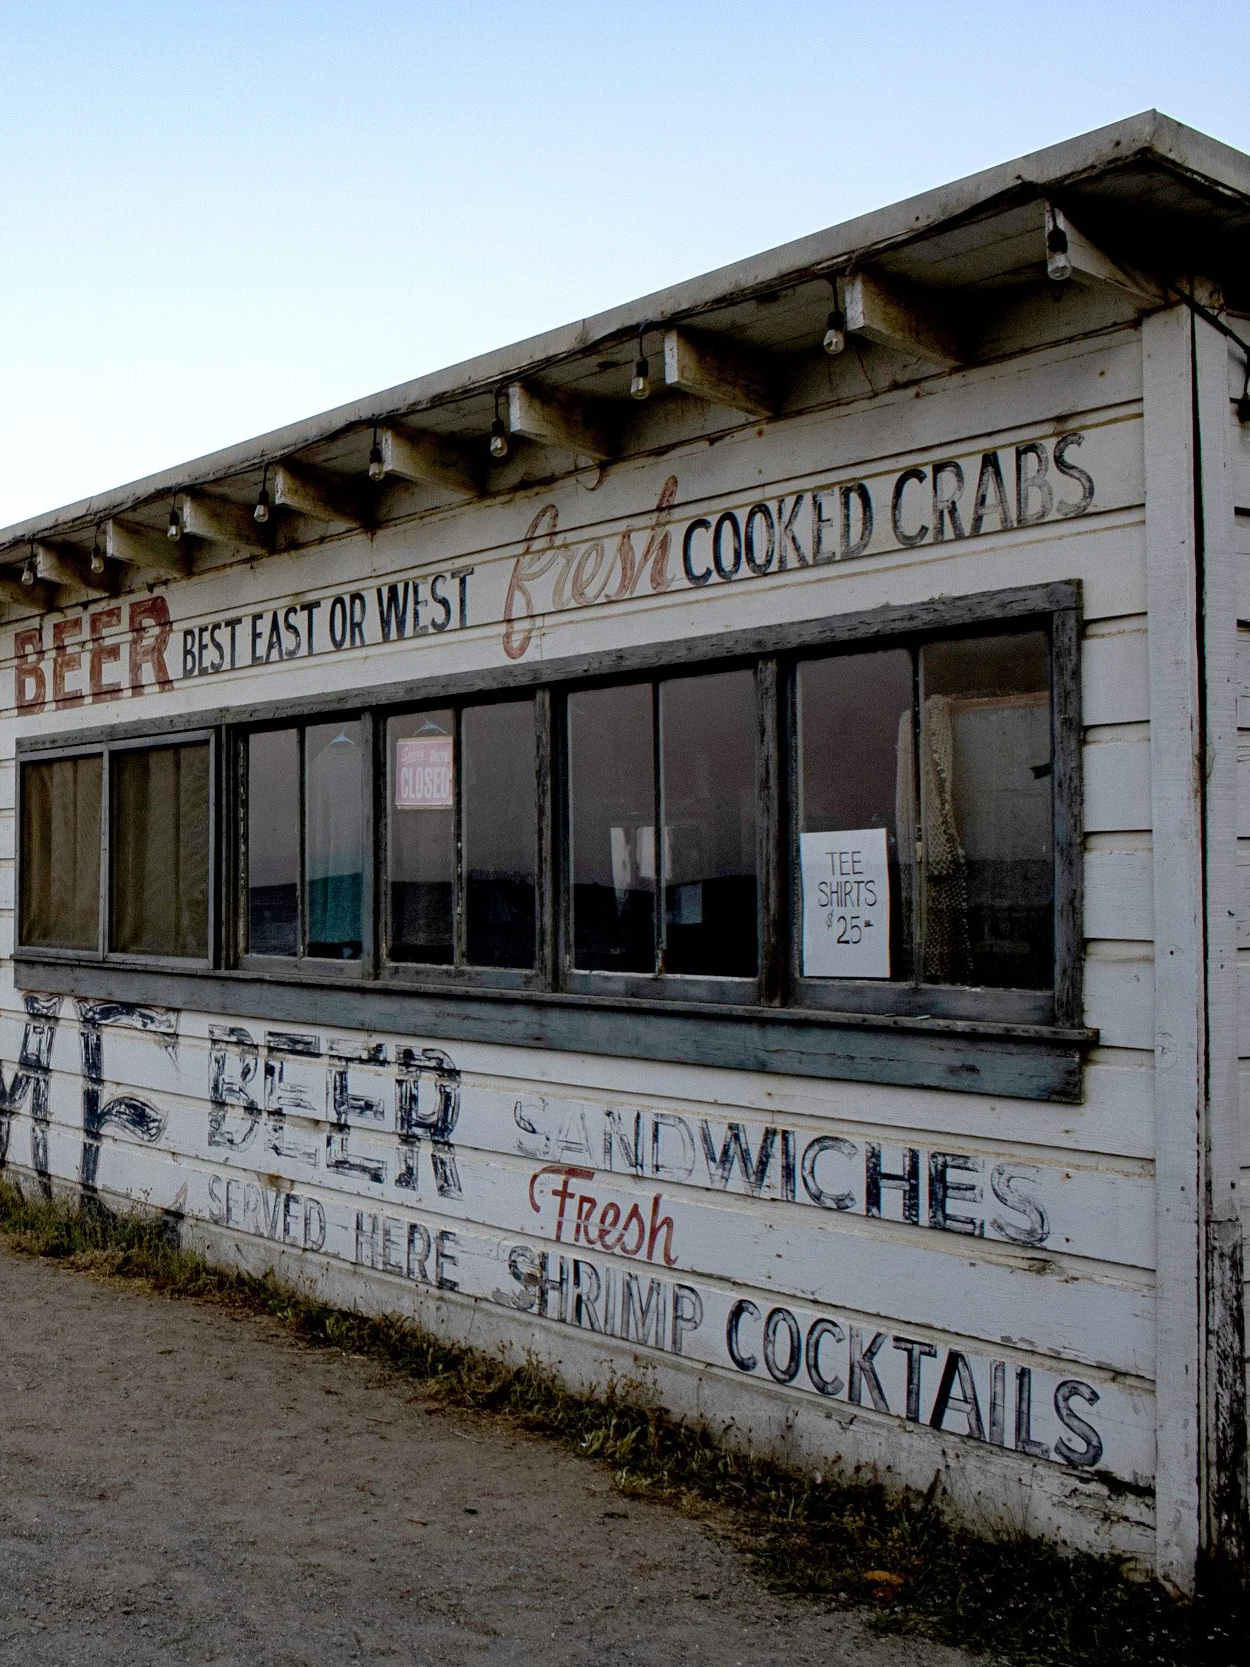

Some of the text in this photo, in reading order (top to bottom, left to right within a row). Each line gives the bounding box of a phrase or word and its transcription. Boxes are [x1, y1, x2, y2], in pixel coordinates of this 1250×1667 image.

[681, 482, 874, 587] COOKED
[891, 432, 1096, 547] CRABS
[14, 595, 175, 718] BEER
[182, 566, 475, 679] BEST EAST OR WEST
[400, 766, 451, 800] CLOSED
[817, 880, 878, 908] SHIRTS
[825, 851, 864, 876] TEE
[208, 1022, 463, 1202] BEER
[513, 1096, 1051, 1247] SANDWICHES
[207, 1173, 460, 1292] SERVED HERE
[529, 1164, 679, 1267] Fresh
[507, 1245, 1104, 1467] SHRIMP COCKTAILS
